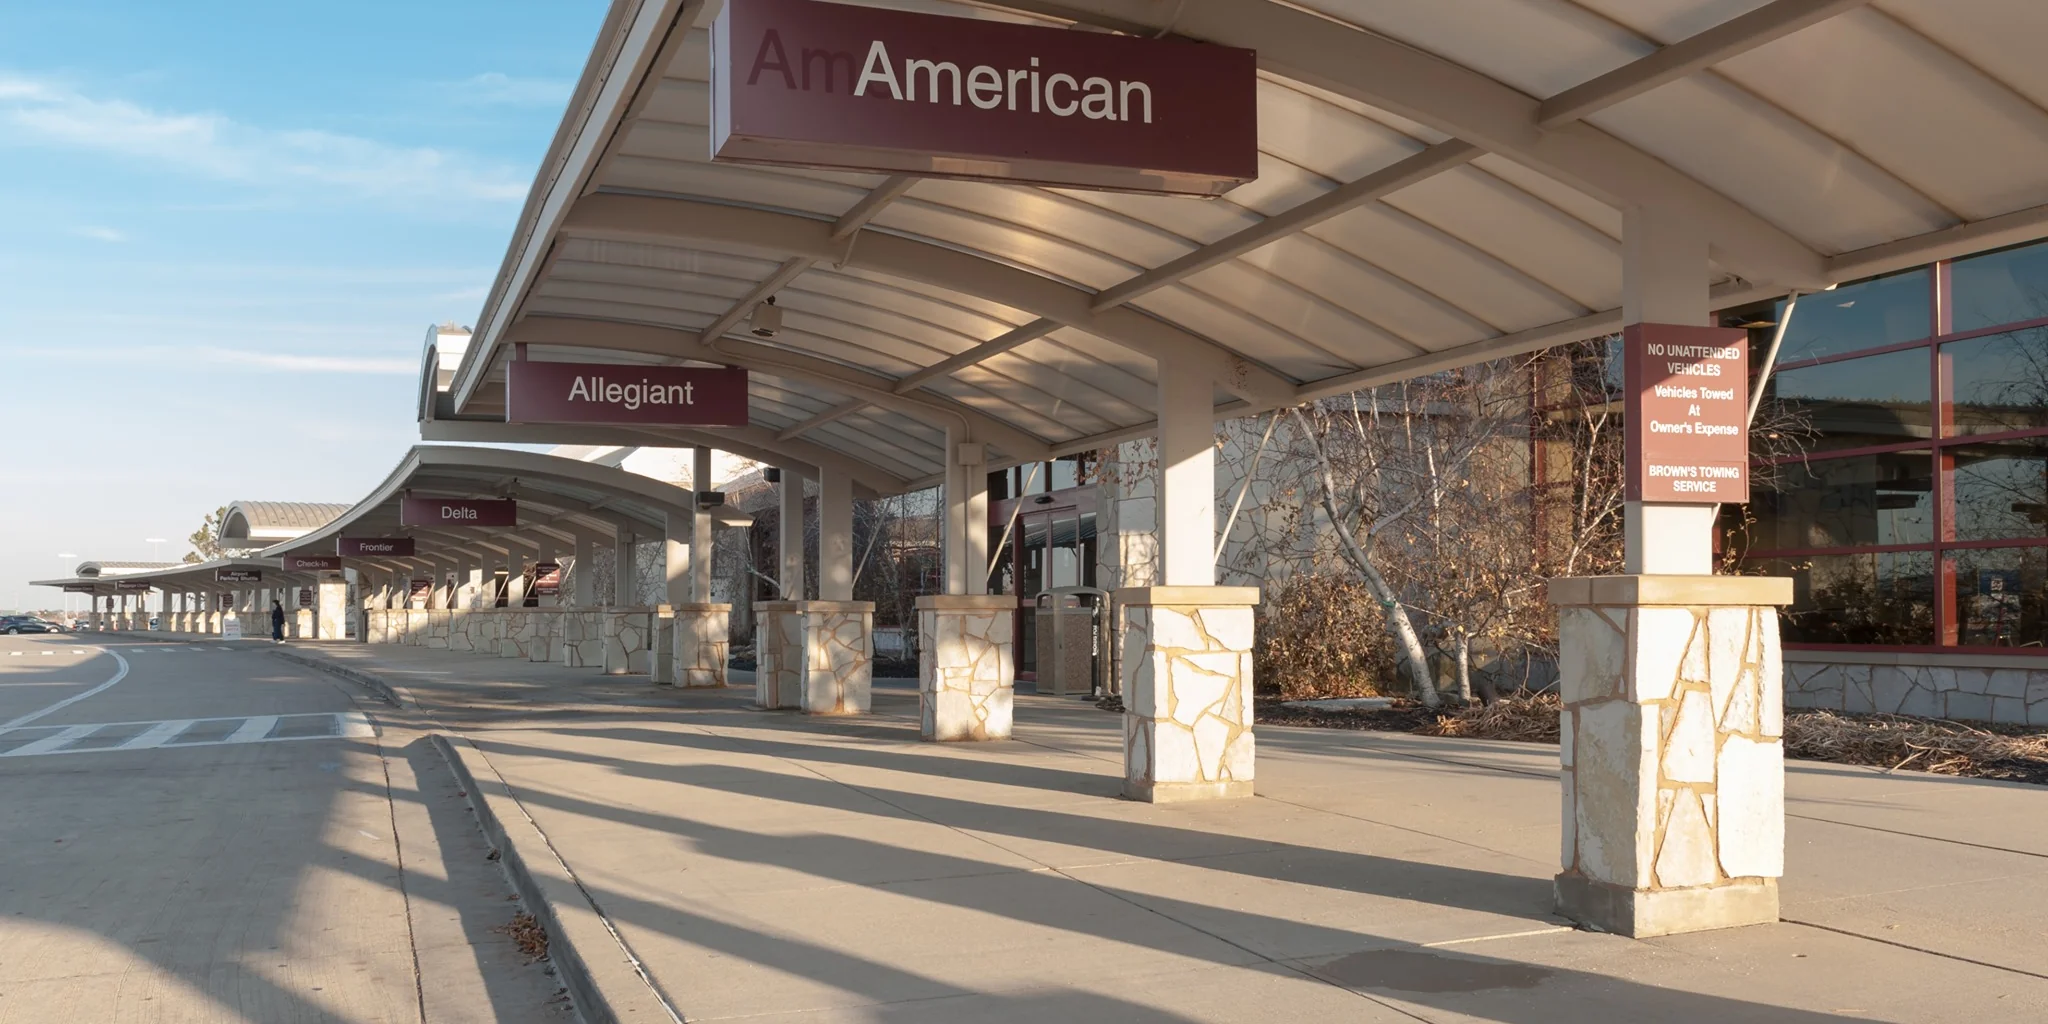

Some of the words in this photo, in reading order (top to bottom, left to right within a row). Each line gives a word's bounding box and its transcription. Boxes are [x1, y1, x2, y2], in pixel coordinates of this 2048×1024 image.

[854, 39, 1153, 124] American
[1648, 343, 1664, 356] NO
[1667, 345, 1740, 360] UNATTENDED
[1667, 362, 1721, 377] VEHICLES
[568, 376, 694, 410] Allegiant
[1654, 385, 1698, 399] Vehicles
[1699, 387, 1734, 400] Towed
[1688, 404, 1701, 416] At
[1650, 420, 1692, 434] Owner's
[1694, 422, 1739, 437] Expense
[1649, 465, 1697, 478] BROWN'S
[1698, 466, 1740, 479] TOWING
[1673, 480, 1717, 493] SERVICE
[441, 505, 478, 520] Delta
[359, 543, 394, 552] Frontier
[296, 560, 328, 568] Check-In
